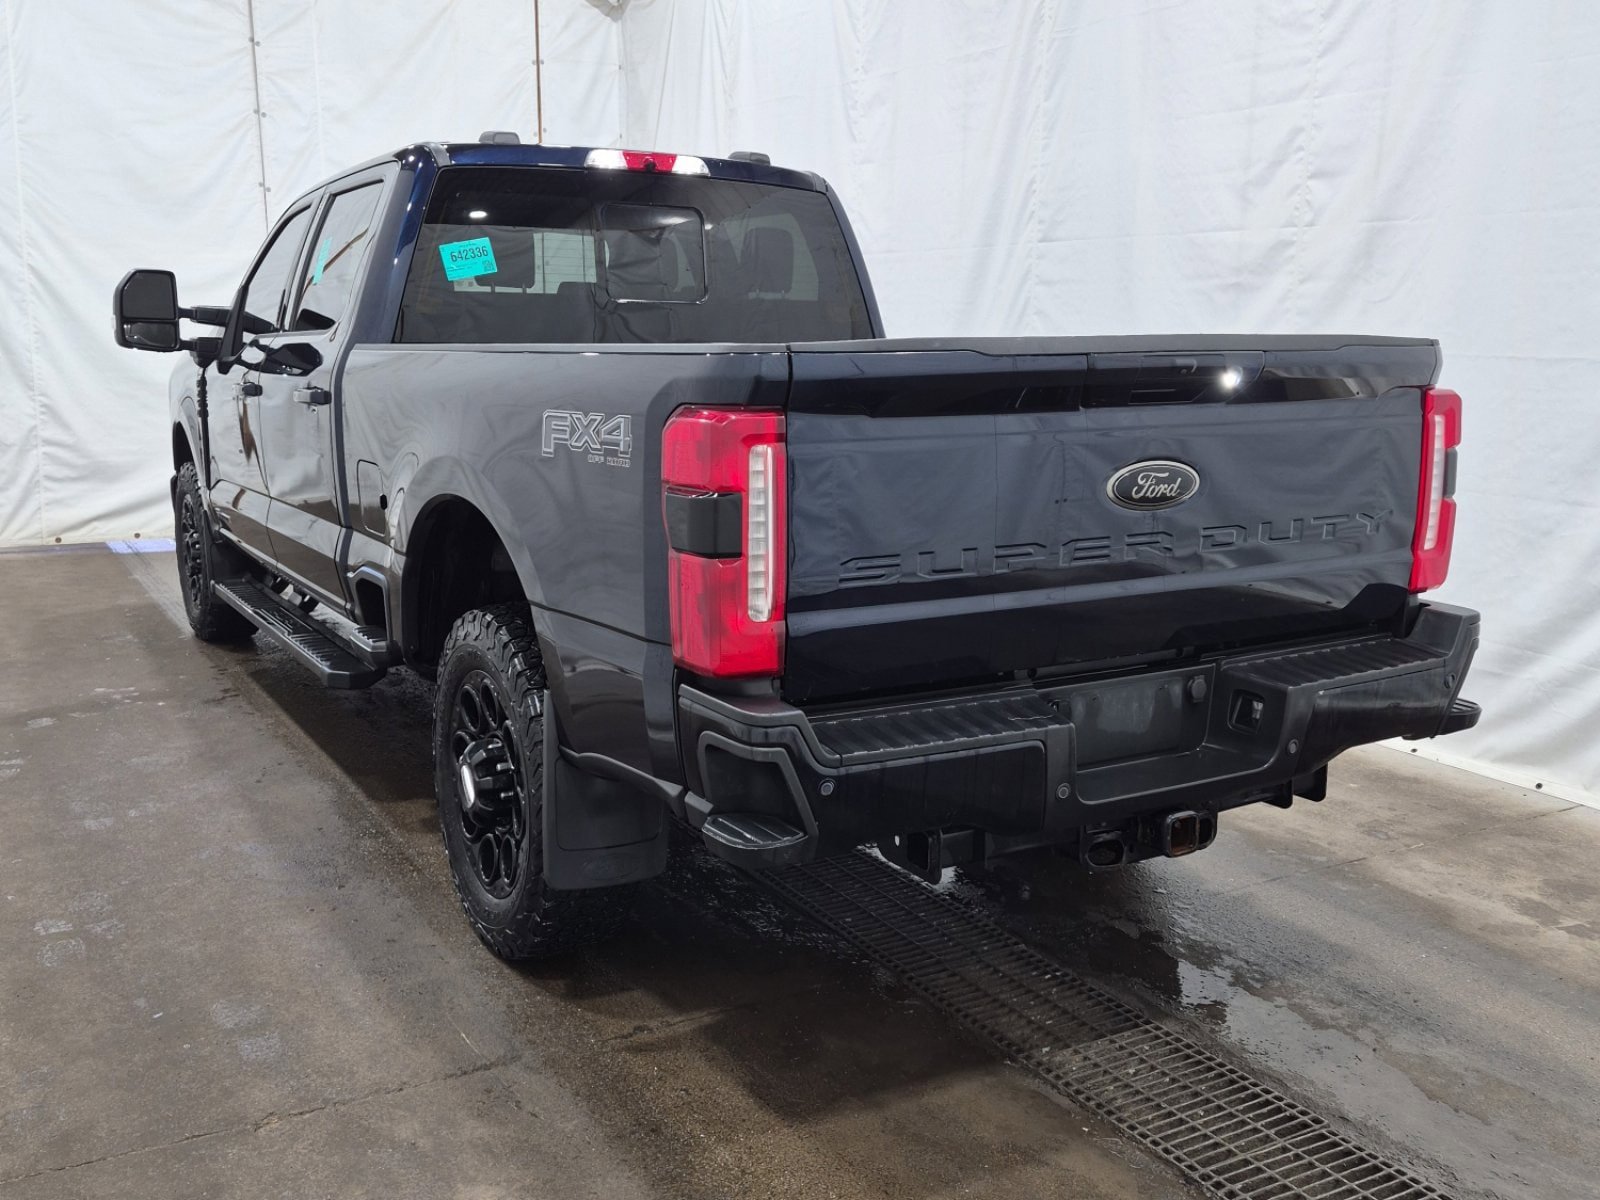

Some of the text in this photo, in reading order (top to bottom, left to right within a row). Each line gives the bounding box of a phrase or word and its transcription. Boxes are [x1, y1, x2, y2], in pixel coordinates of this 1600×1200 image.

[450, 246, 489, 262] 642336
[542, 409, 632, 457] FX4
[1131, 472, 1181, 499] Ford
[838, 509, 1394, 588] SUPER DUTY
